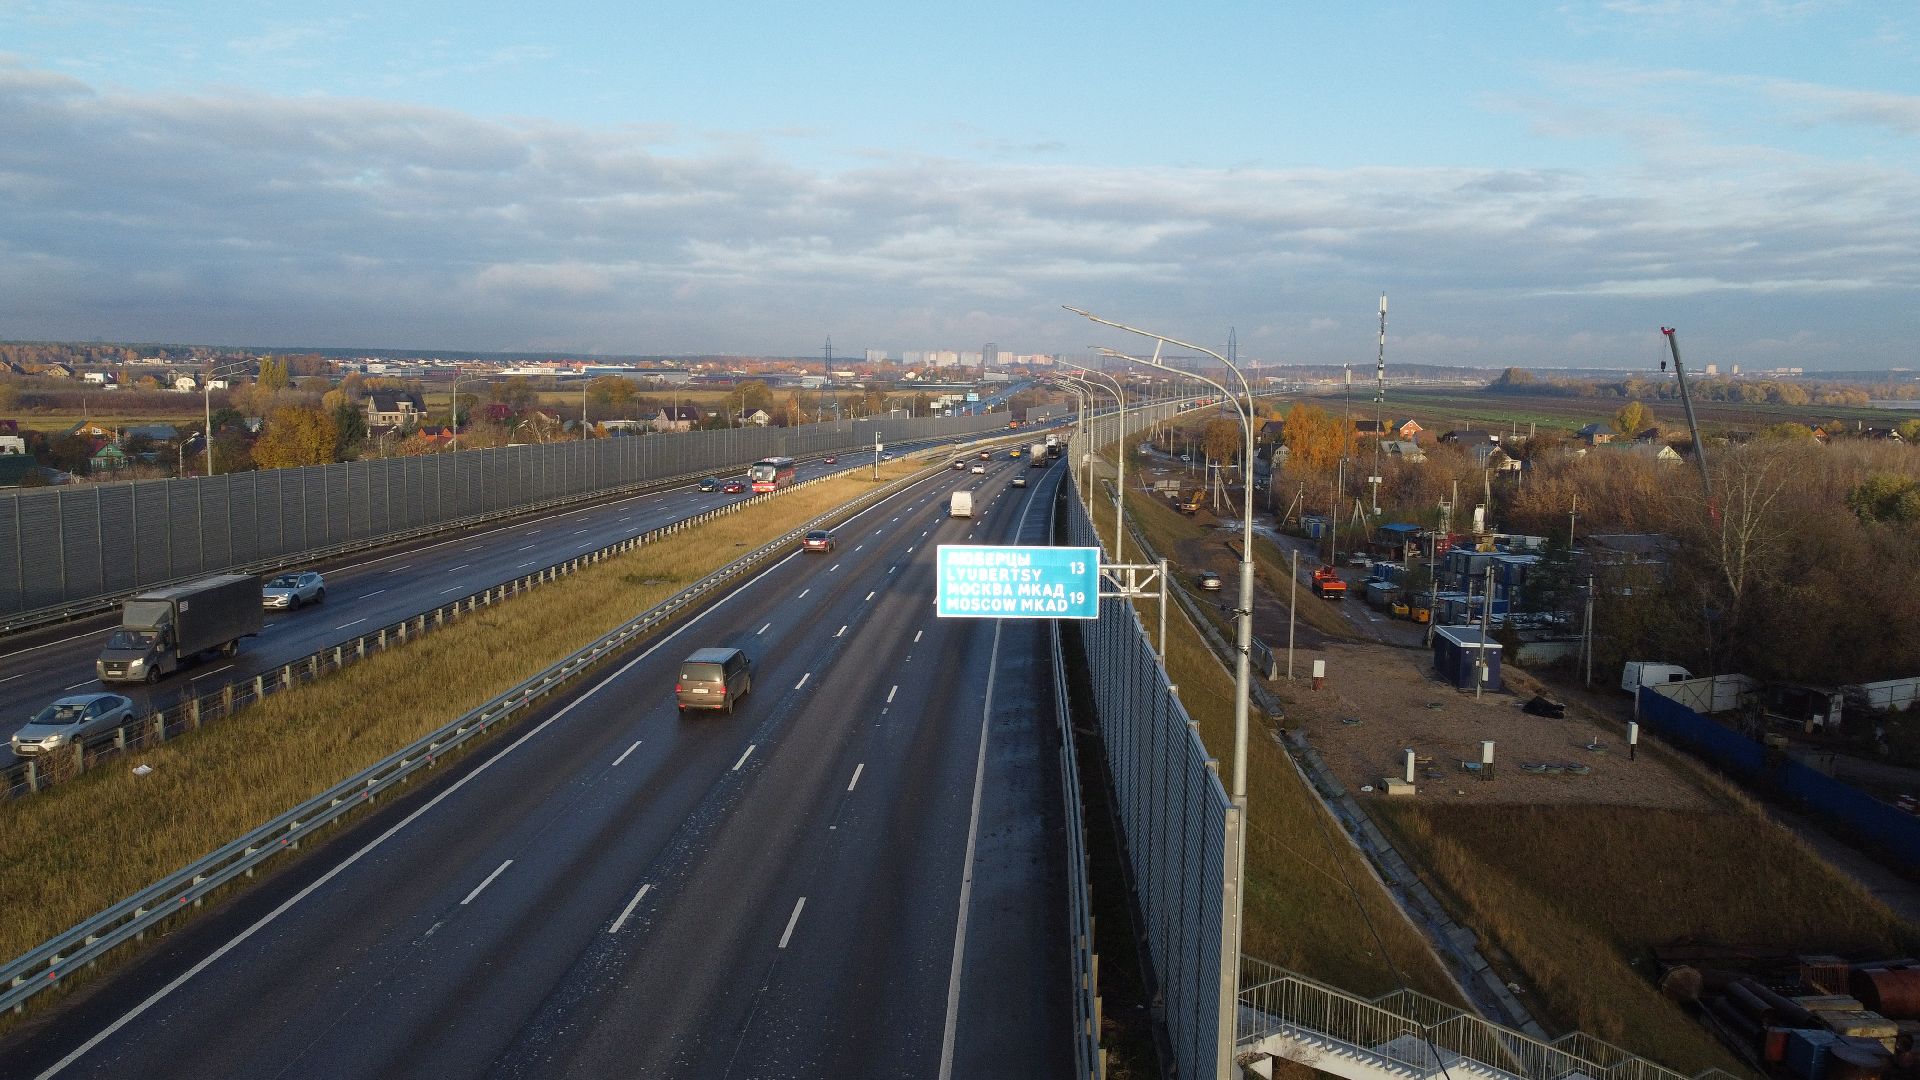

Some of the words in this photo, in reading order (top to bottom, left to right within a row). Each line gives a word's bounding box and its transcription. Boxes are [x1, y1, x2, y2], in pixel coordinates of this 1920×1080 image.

[946, 568, 1042, 582] LYUBERTSY
[1070, 562, 1085, 575] 13
[946, 583, 1013, 596] МОСКВА
[1018, 583, 1065, 598] МКАД
[946, 598, 1017, 612] MOSCOW
[1020, 599, 1068, 612] MKAD
[1070, 592, 1085, 604] 19
